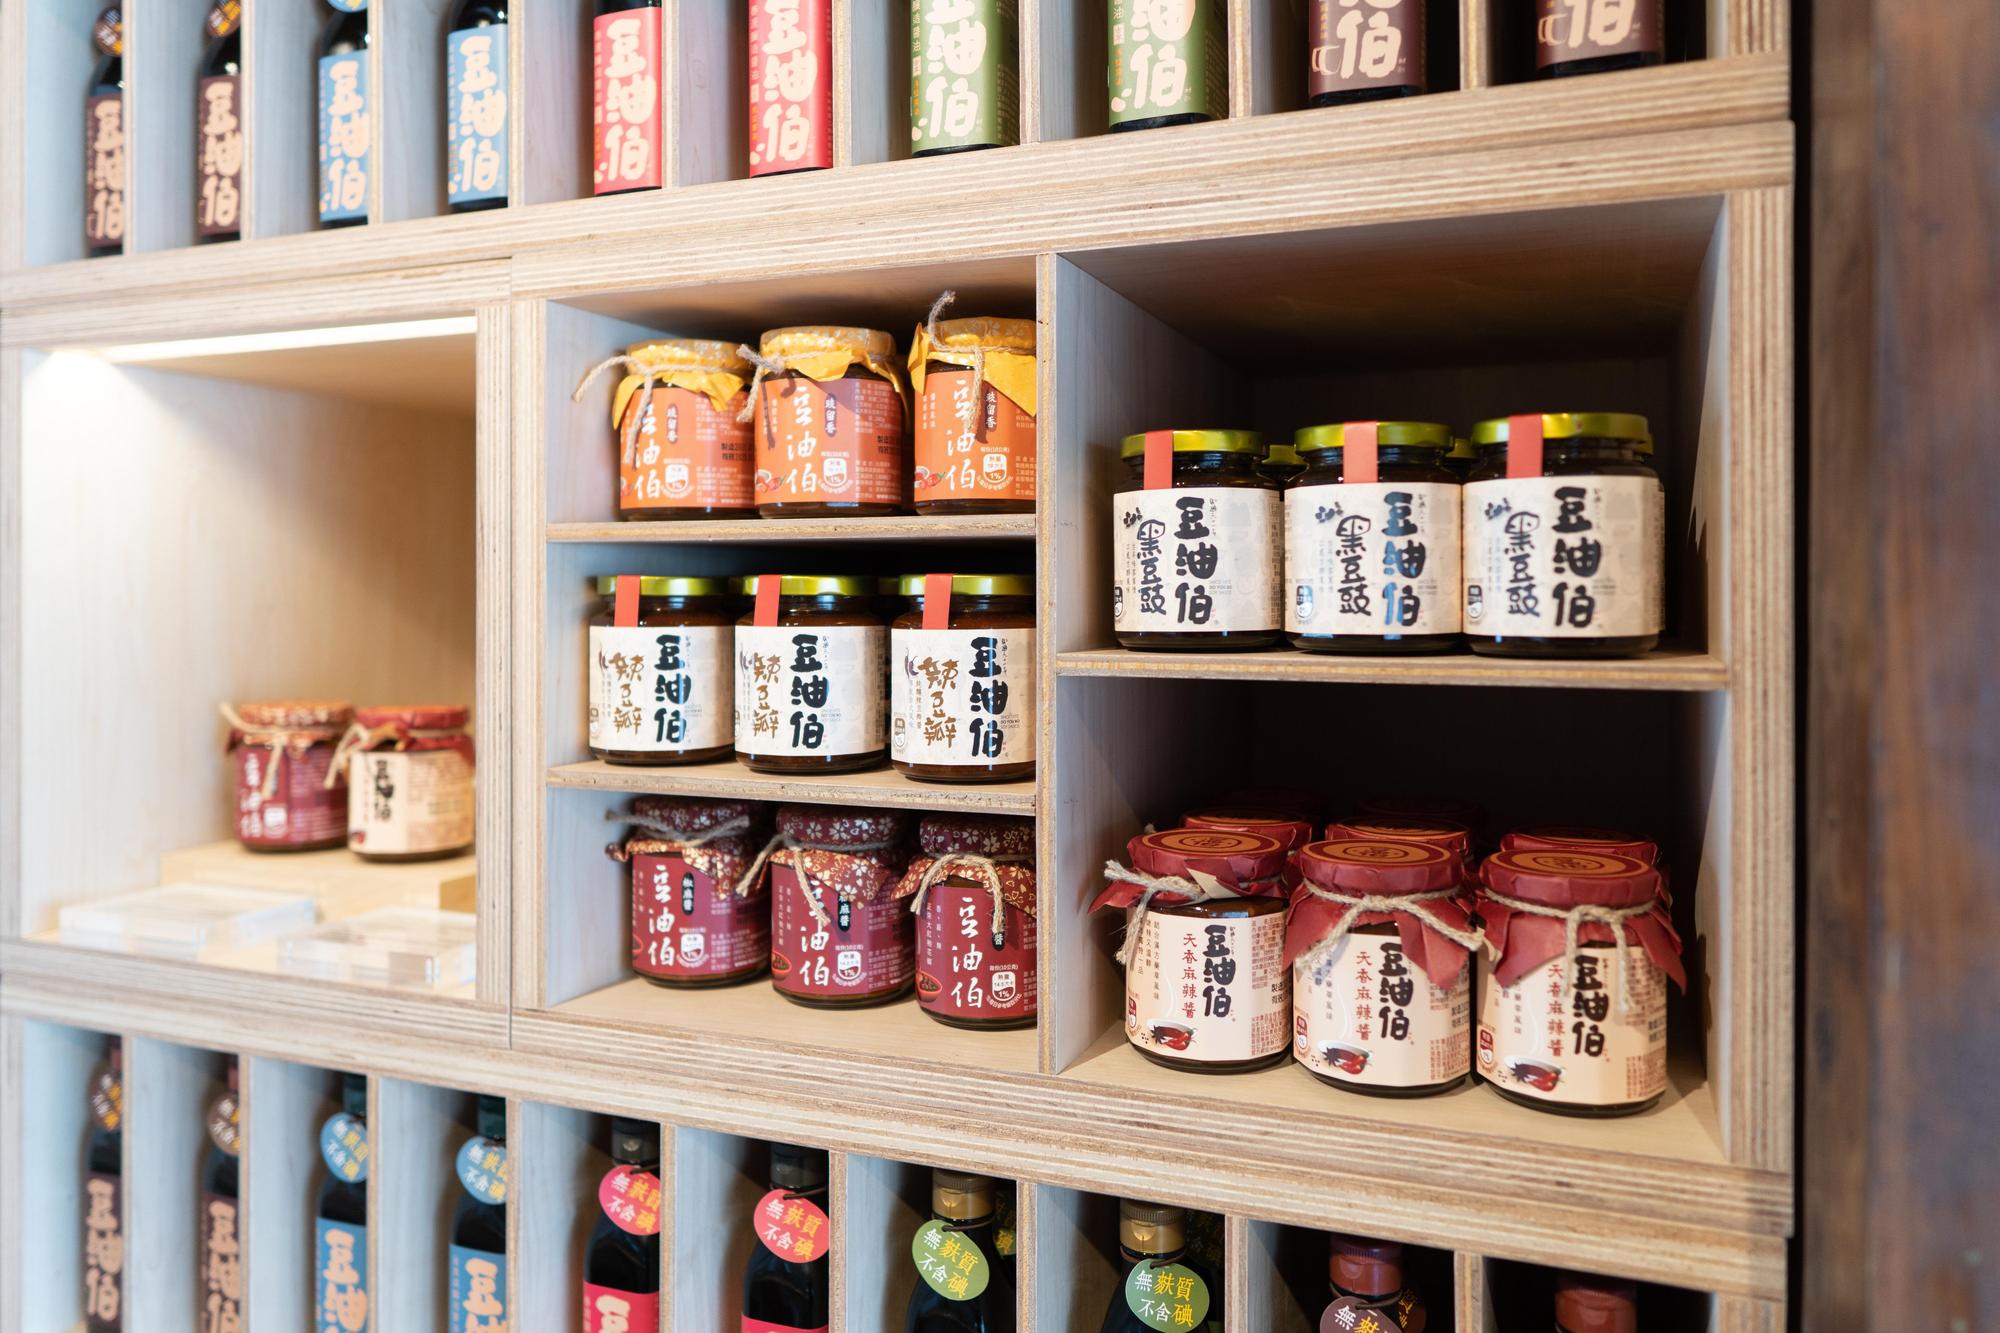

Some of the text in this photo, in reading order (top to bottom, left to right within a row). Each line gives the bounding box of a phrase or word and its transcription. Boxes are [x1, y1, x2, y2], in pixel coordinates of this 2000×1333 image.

[458, 36, 507, 192] 豆油伯
[604, 19, 657, 181] 豆油伯
[762, 0, 818, 163] 豆油伯
[786, 386, 818, 495] 豆油伯
[1174, 496, 1218, 625] 豆油伯
[1381, 491, 1426, 626] 豆油伯
[1552, 486, 1601, 628] 豆油伯
[654, 634, 692, 743] 豆油伯
[790, 633, 829, 749] 豆油伯
[968, 636, 1008, 758] 豆油伯
[648, 864, 675, 966] 豆油伯
[951, 897, 983, 1009] 豆油伯
[1181, 933, 1197, 1019] 天香麻辣醬
[1202, 924, 1236, 1018] 豆油伯
[1355, 951, 1373, 1041] 天香麻辣醬
[1378, 942, 1414, 1041] 豆油伯
[1547, 964, 1565, 1057] 天香麻辣醬
[1572, 955, 1609, 1058] 豆油伯
[763, 1224, 816, 1261] 不含碘
[766, 1199, 823, 1238] 無麩質
[923, 1228, 978, 1275] 無麩質
[323, 1228, 368, 1333] 豆油
[919, 1253, 969, 1299] 不含碘
[1135, 1269, 1195, 1301] 無麩質
[1137, 1298, 1194, 1328] 不含碘
[1334, 1305, 1389, 1333] 無麩
